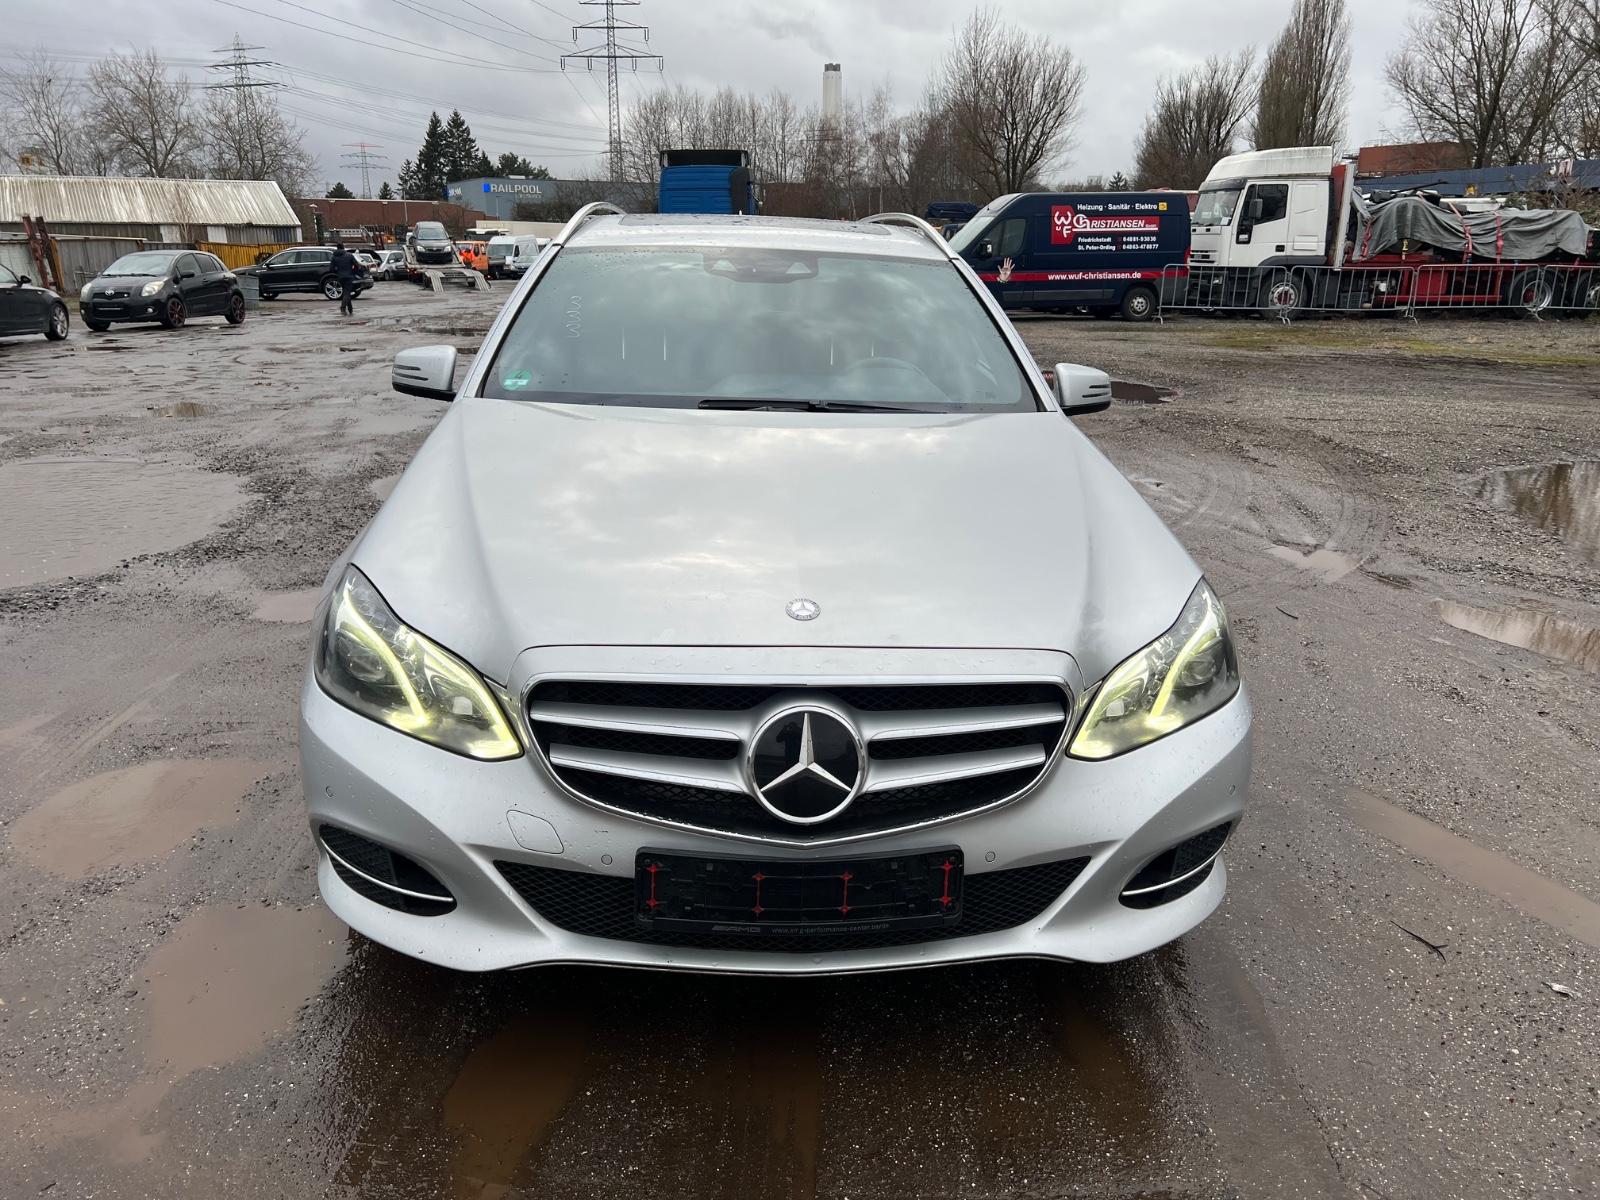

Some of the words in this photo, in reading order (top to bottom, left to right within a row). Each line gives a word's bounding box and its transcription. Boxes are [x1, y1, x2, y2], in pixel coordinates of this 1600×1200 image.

[490, 183, 542, 194] RAILPOOL
[1077, 203, 1103, 211] Heizung
[1047, 272, 1141, 281] www.wuf-christiansen.de
